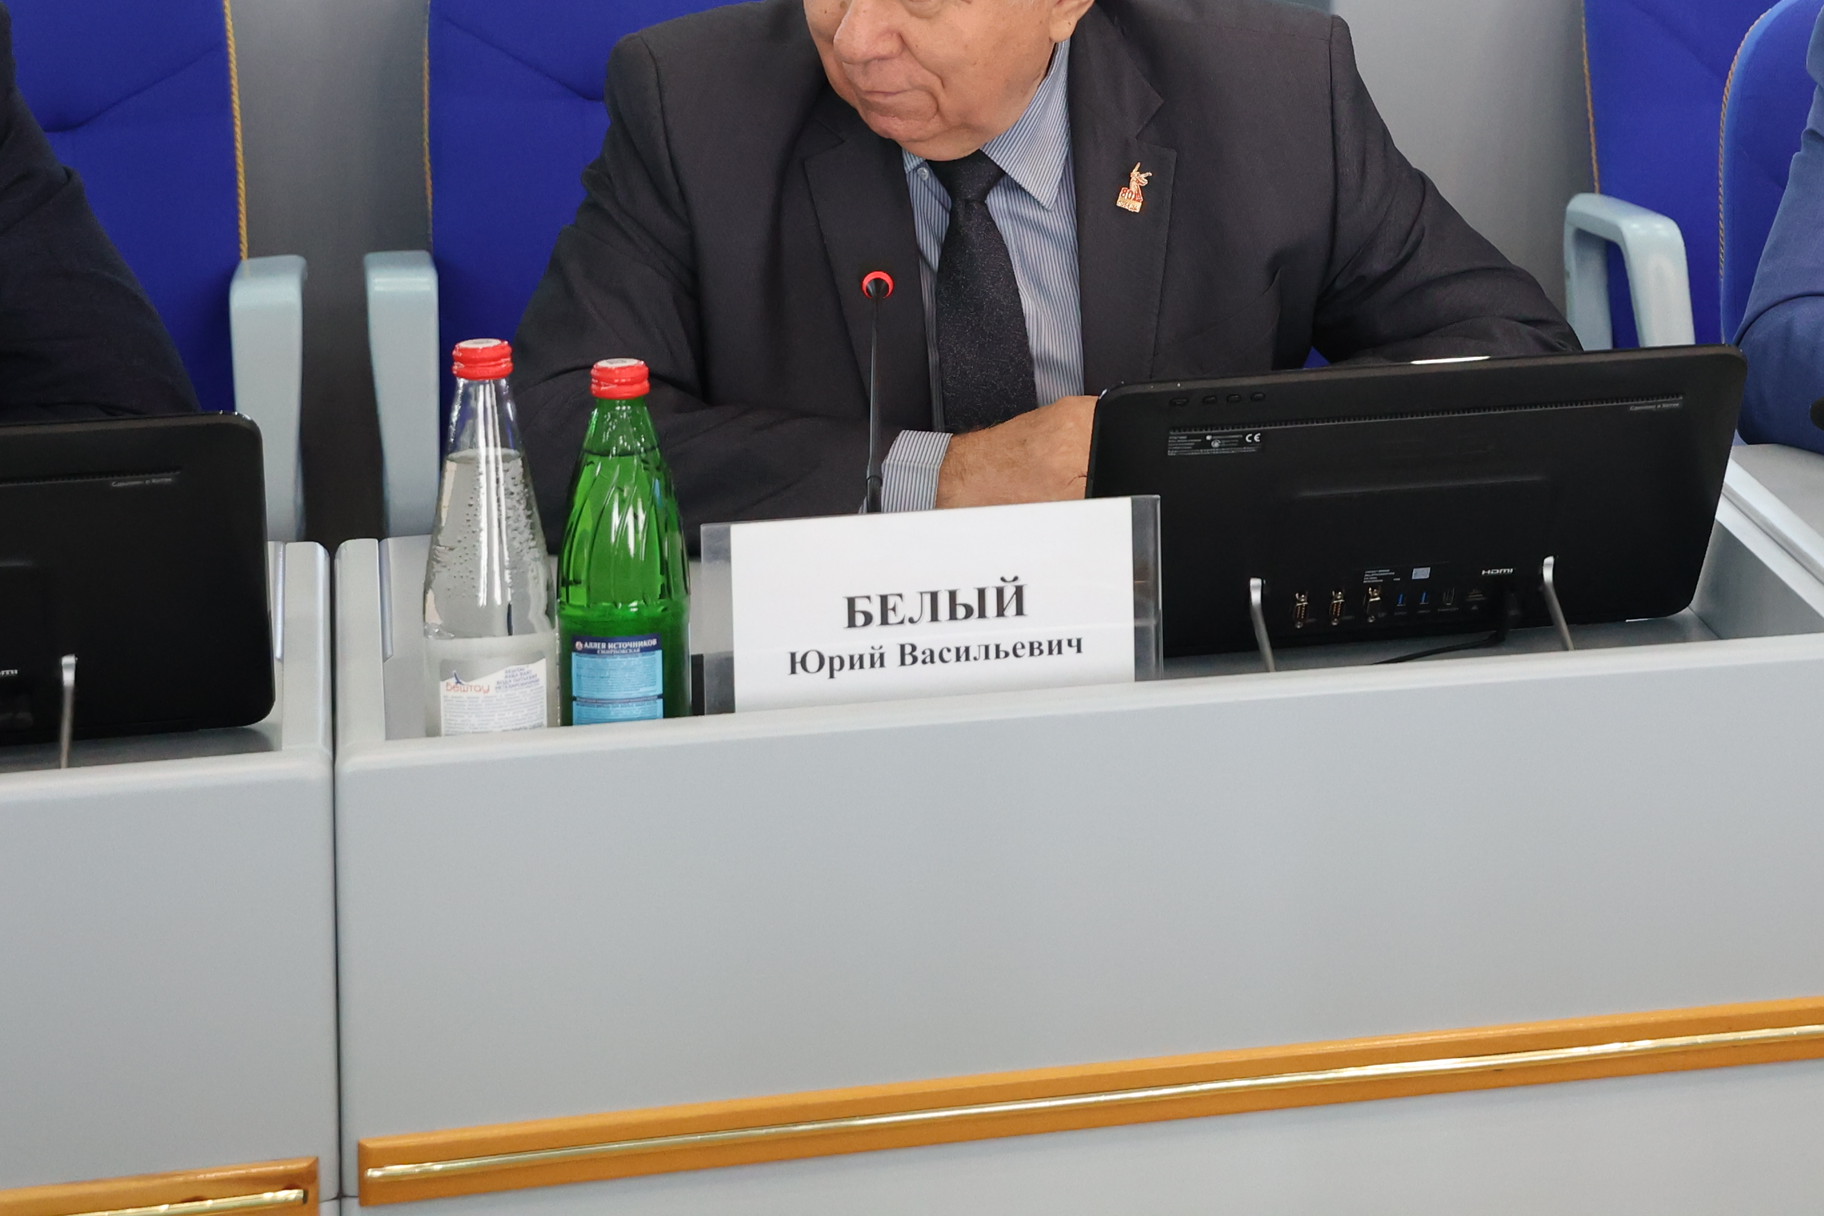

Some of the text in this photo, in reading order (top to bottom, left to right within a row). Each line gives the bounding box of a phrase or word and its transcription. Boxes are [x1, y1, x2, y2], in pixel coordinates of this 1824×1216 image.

[843, 576, 1028, 628] БЕЛЫЙ
[788, 636, 1083, 679] Юрий Васильевич
